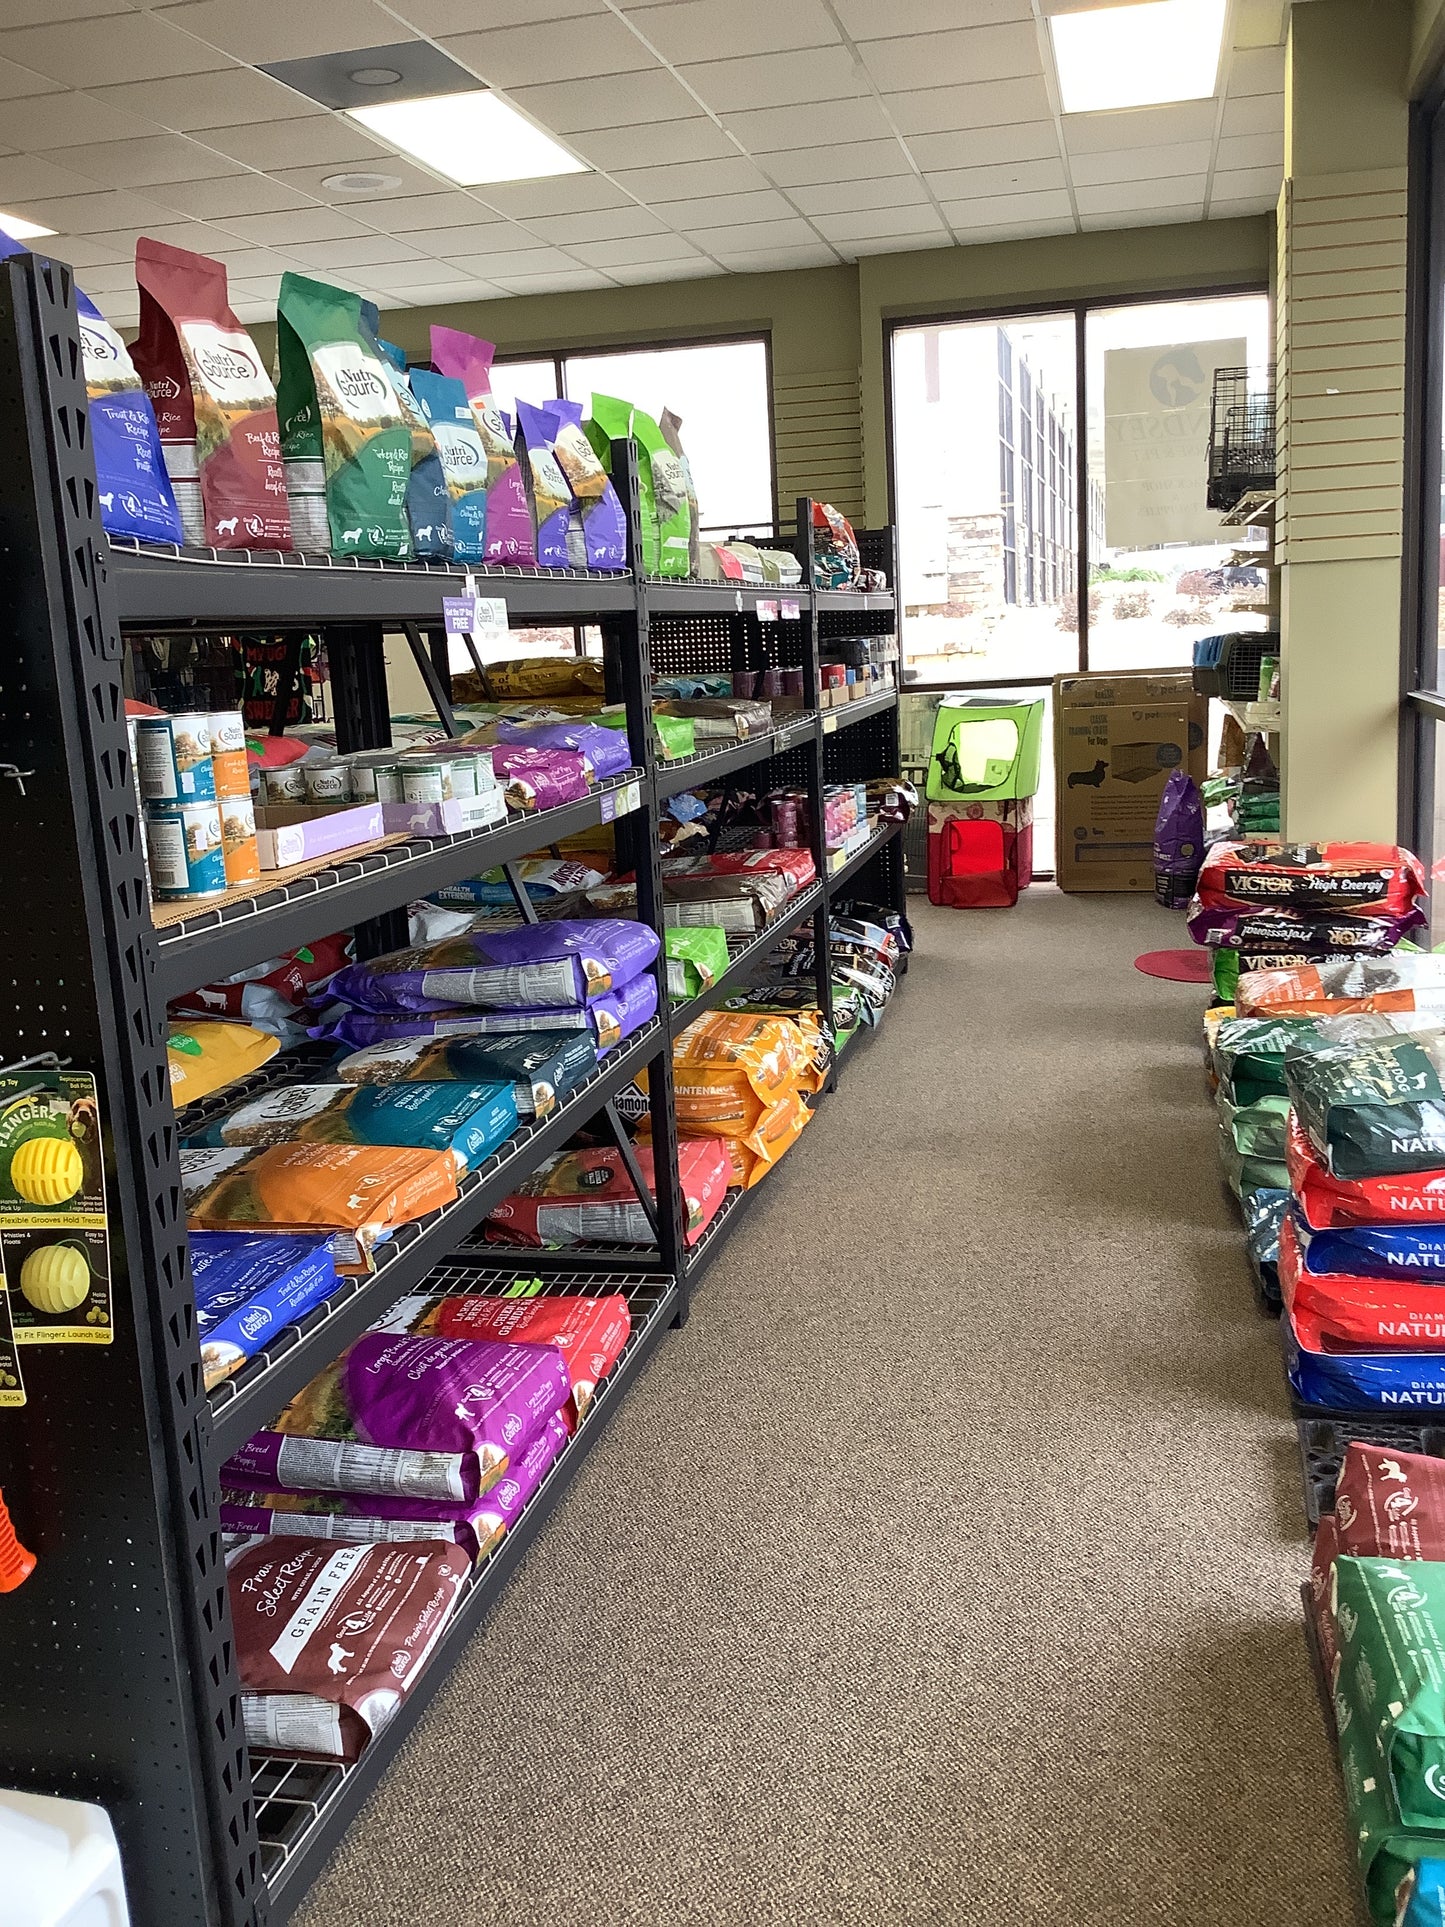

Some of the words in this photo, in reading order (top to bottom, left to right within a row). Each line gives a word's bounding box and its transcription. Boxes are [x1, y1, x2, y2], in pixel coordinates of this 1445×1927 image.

[204, 349, 236, 366] Nutri
[202, 360, 250, 378] Source
[340, 369, 371, 382] Nutr
[341, 382, 379, 396] Sourc
[266, 645, 287, 661] UG
[316, 783, 338, 791] Source
[320, 778, 335, 786] Nutri
[1229, 876, 1295, 891] VICTOR
[1310, 877, 1338, 891] High
[1341, 878, 1384, 893] Energy
[438, 891, 475, 901] EXTENSION
[1241, 926, 1315, 942] Professional
[1241, 954, 1308, 970] VICTOR
[7, 1079, 19, 1087] Toy
[1394, 1067, 1412, 1093] DOG
[673, 1085, 736, 1096] AINTENANCE
[613, 1096, 650, 1110] iamon
[0, 1217, 28, 1225] Flexible
[243, 1309, 262, 1325] Nutri
[245, 1314, 269, 1336] Source
[498, 1303, 527, 1336] GRANDE
[37, 1331, 65, 1339] Flingerz
[95, 1331, 110, 1339] Stick
[1378, 1322, 1445, 1337] NATU
[366, 1352, 390, 1375] Large
[1381, 1391, 1445, 1405] NATU
[256, 1577, 293, 1619] Select
[290, 1585, 332, 1640] GRAIN
[346, 1618, 365, 1631] 4
[403, 1624, 424, 1648] Prairie
[418, 1602, 438, 1632] Select
